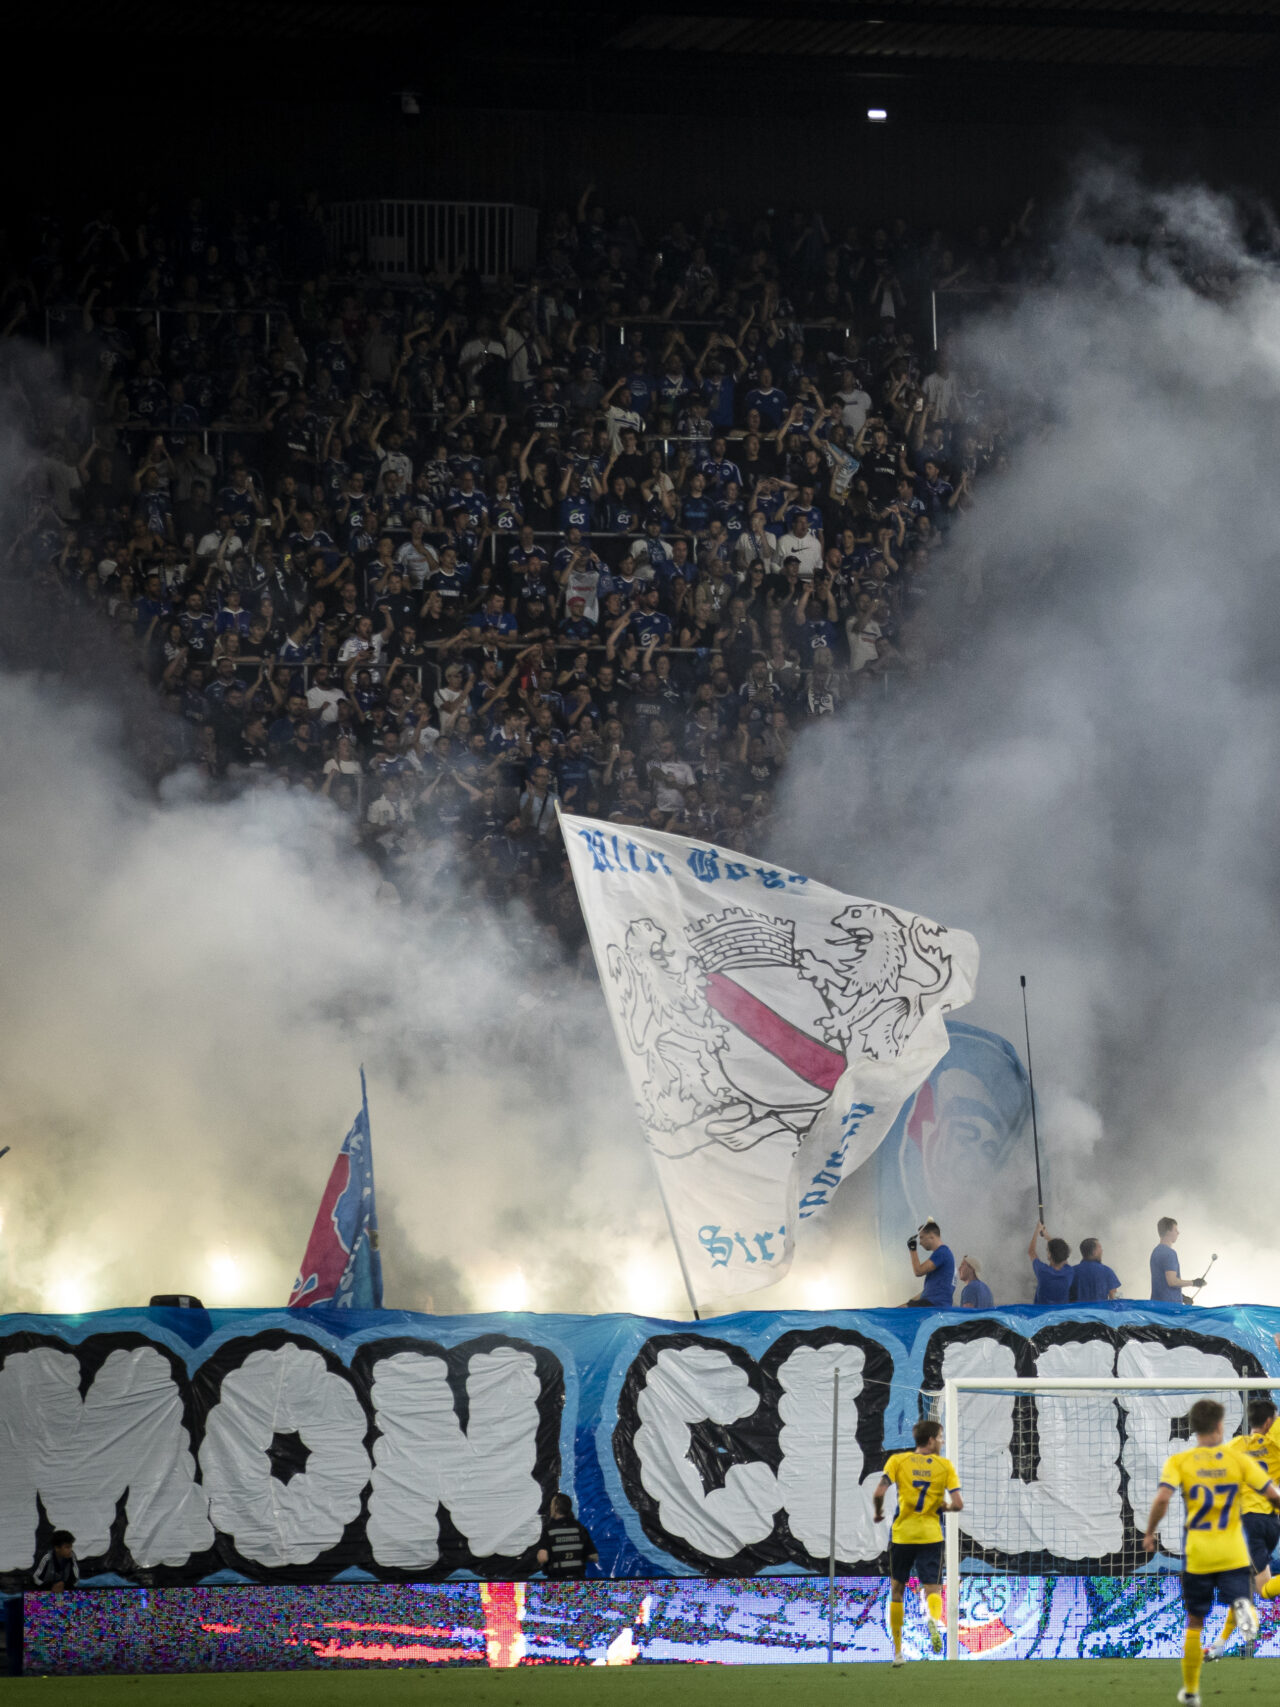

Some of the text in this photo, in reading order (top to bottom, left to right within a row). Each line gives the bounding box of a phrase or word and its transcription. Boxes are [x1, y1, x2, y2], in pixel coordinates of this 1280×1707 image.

[0, 1330, 564, 1582] MON
[911, 1480, 932, 1512] 7
[1188, 1484, 1239, 1531] 27
